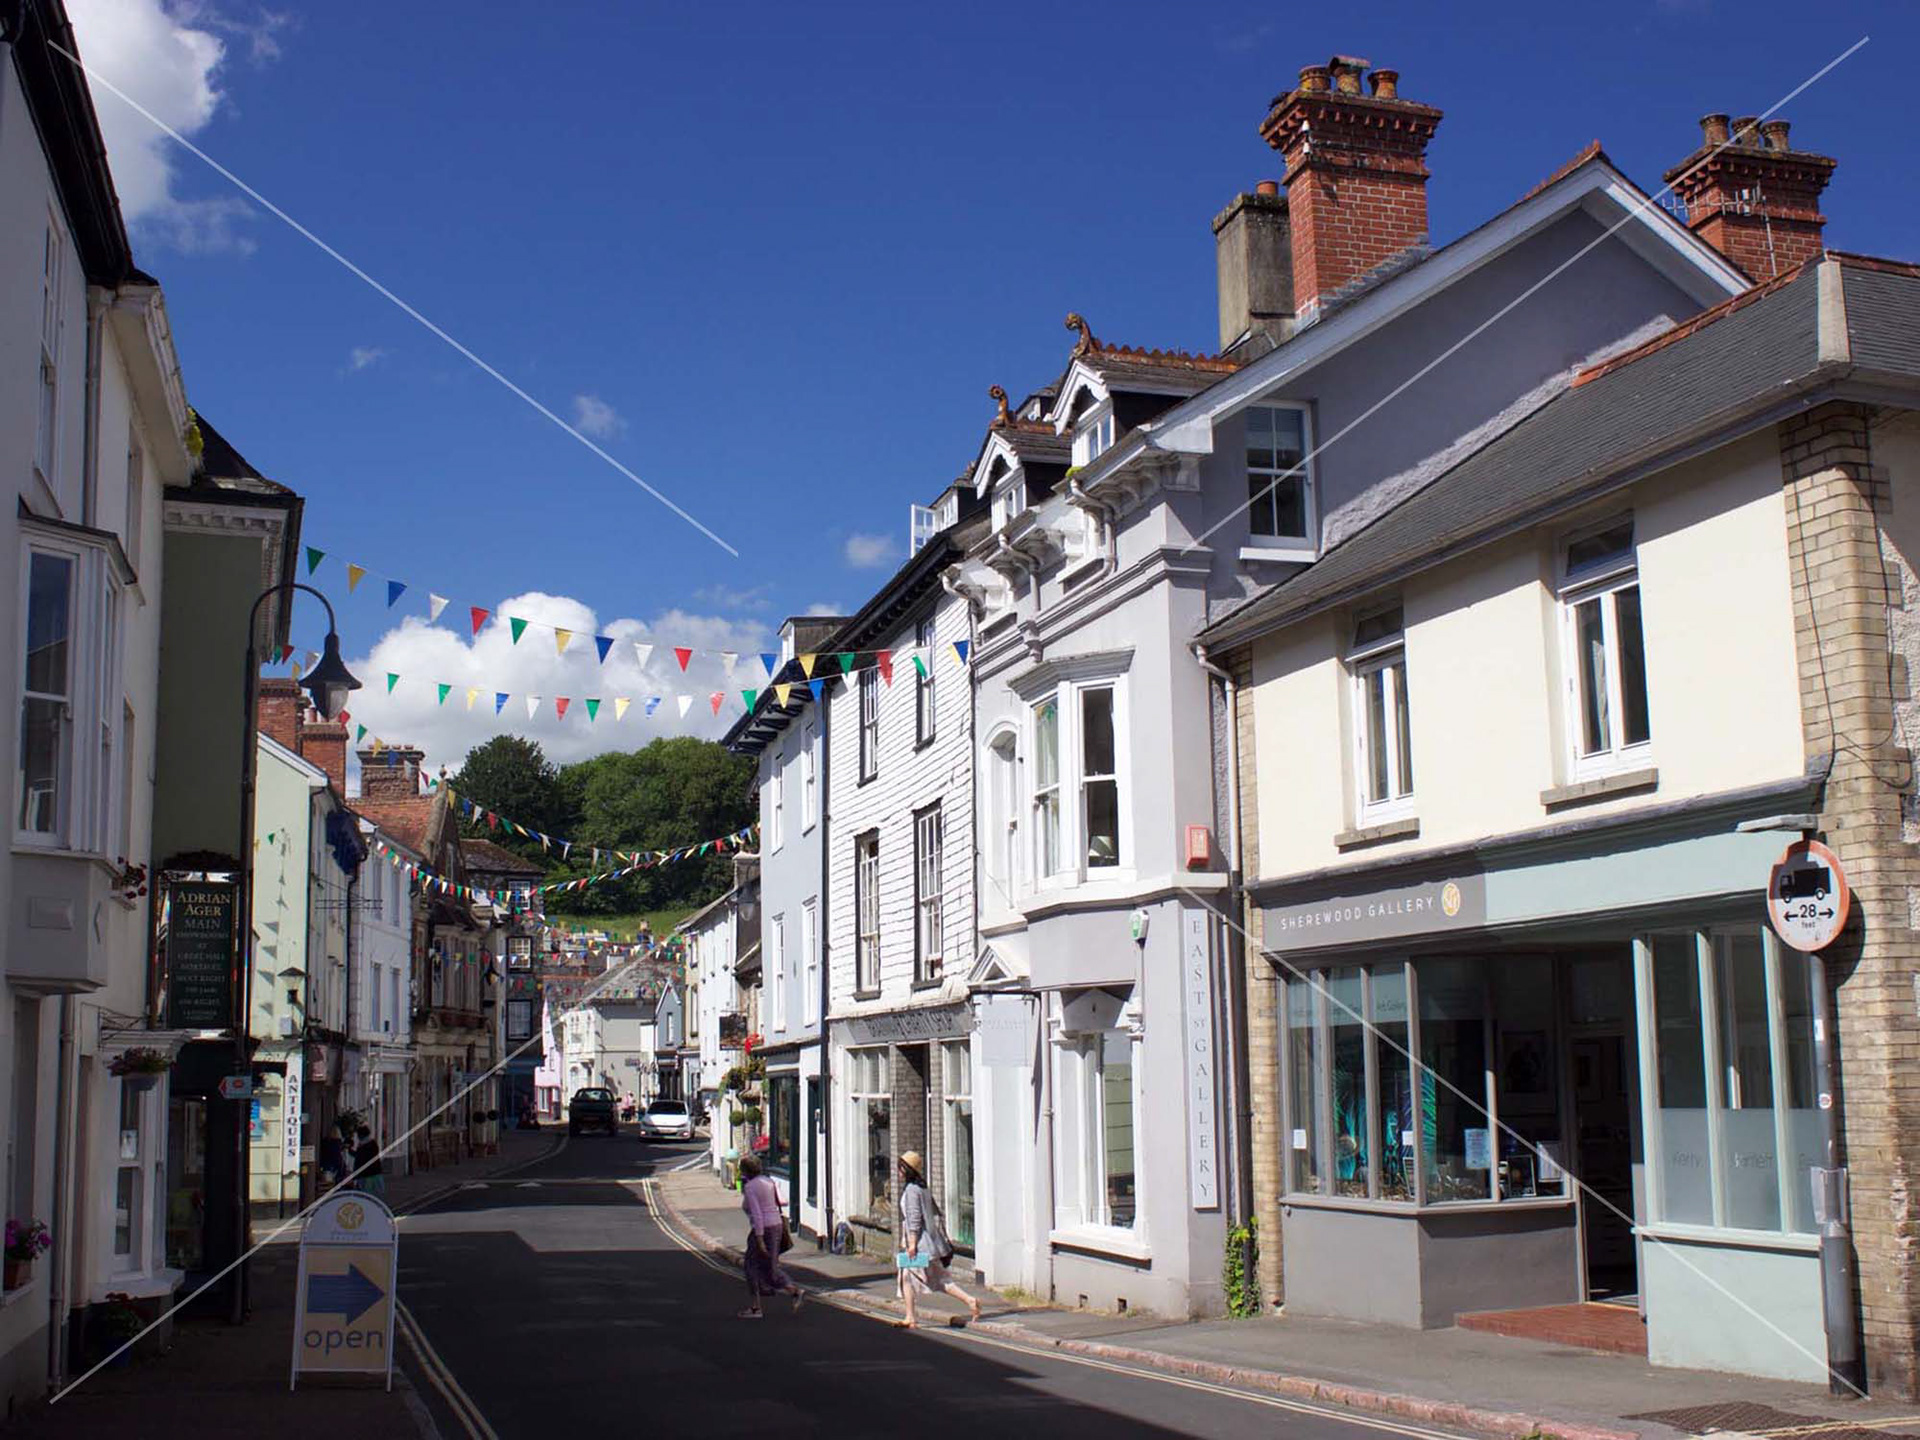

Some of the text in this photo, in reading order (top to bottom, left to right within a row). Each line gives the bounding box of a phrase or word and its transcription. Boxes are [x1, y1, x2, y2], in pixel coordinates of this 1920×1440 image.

[177, 891, 231, 904] ADRIAN
[184, 904, 222, 916] AGER
[184, 918, 221, 930] MAIN
[1280, 897, 1434, 931] SHEREWOOD GALLERY
[1799, 904, 1817, 918] 28
[1191, 920, 1206, 1005] EAST
[287, 1074, 298, 1157] ANTIQUES
[1194, 1038, 1211, 1198] GALLERY
[304, 1329, 384, 1355] open
